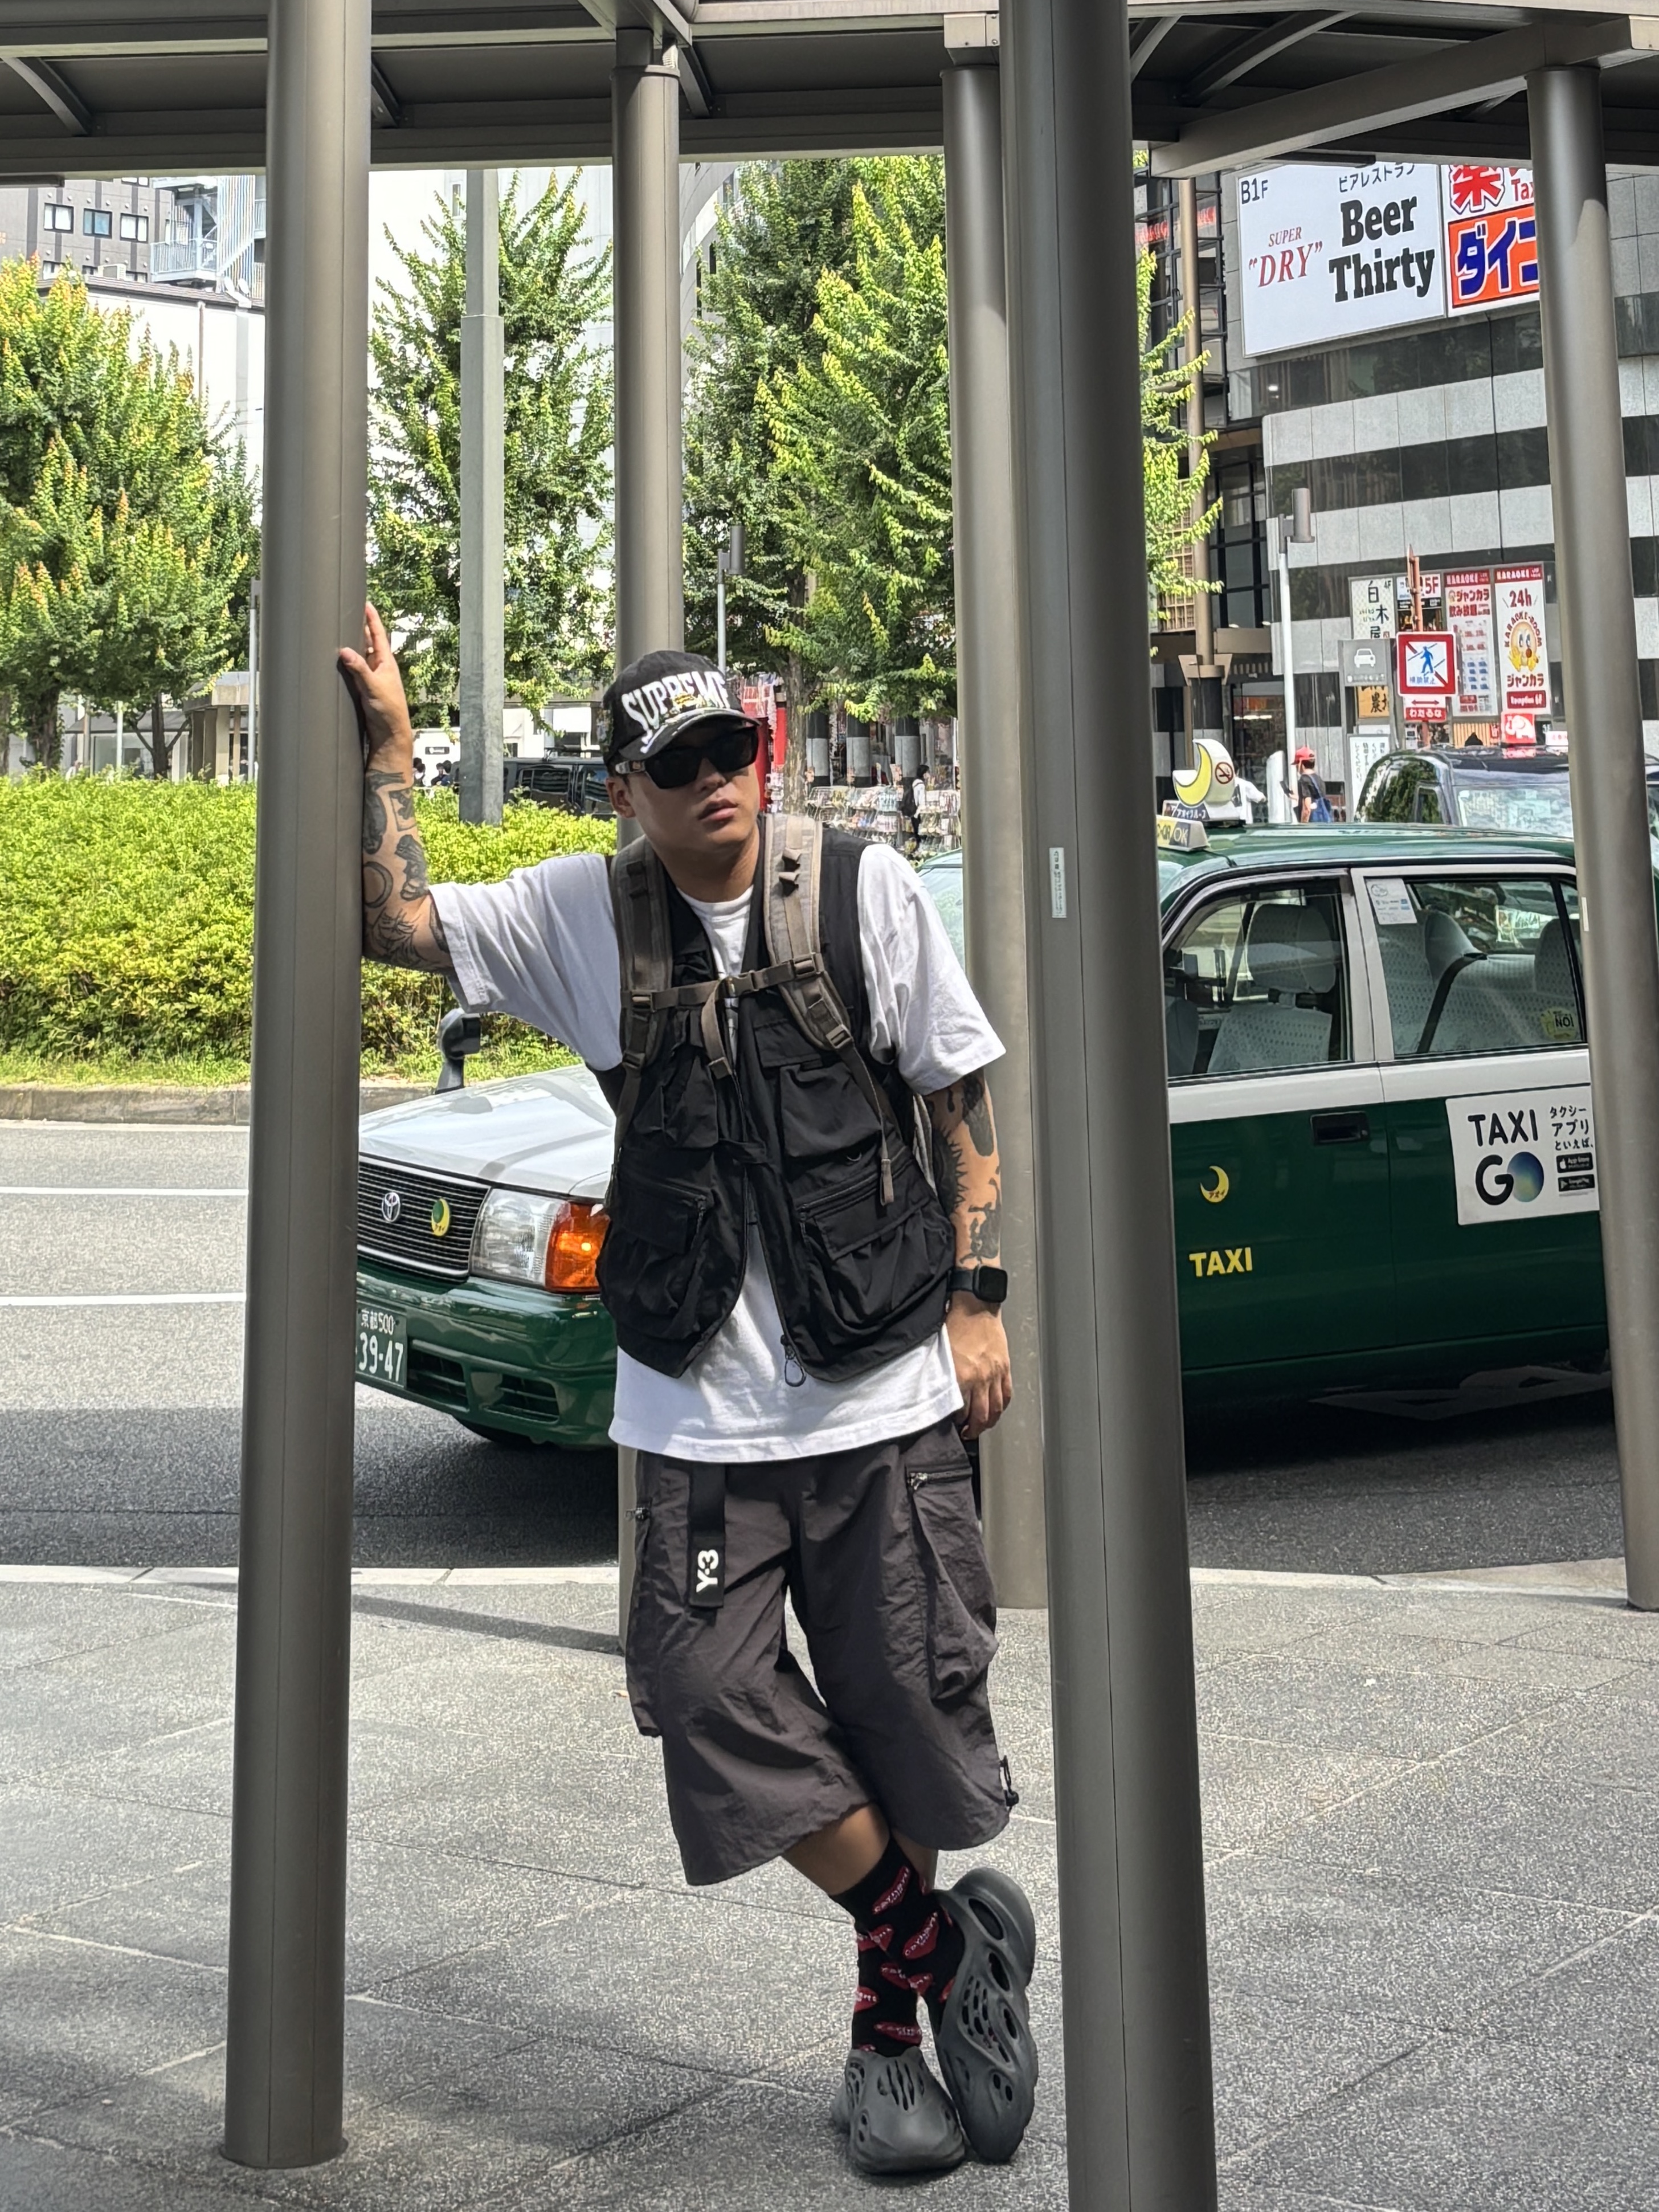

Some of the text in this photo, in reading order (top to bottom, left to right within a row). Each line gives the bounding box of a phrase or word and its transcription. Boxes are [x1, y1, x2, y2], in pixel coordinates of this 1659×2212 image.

[1241, 178, 1268, 205] B1F
[1341, 196, 1417, 247] Beer
[1268, 226, 1302, 247] SUPER
[1329, 247, 1435, 303] Thirty
[1425, 576, 1439, 594] 5F
[1456, 588, 1490, 602] ジャンカラ
[1509, 588, 1532, 607] 24h
[1507, 673, 1544, 687] ジャンカラ
[621, 671, 732, 745] SUPREME
[1409, 708, 1443, 718] わたるな
[1174, 827, 1188, 846] OK
[1550, 1105, 1587, 1119] タクシー
[1468, 1109, 1539, 1146] TAXI
[1551, 1119, 1589, 1137] アプリ
[1190, 1247, 1253, 1277] TAXI
[358, 1332, 403, 1382] 39-47
